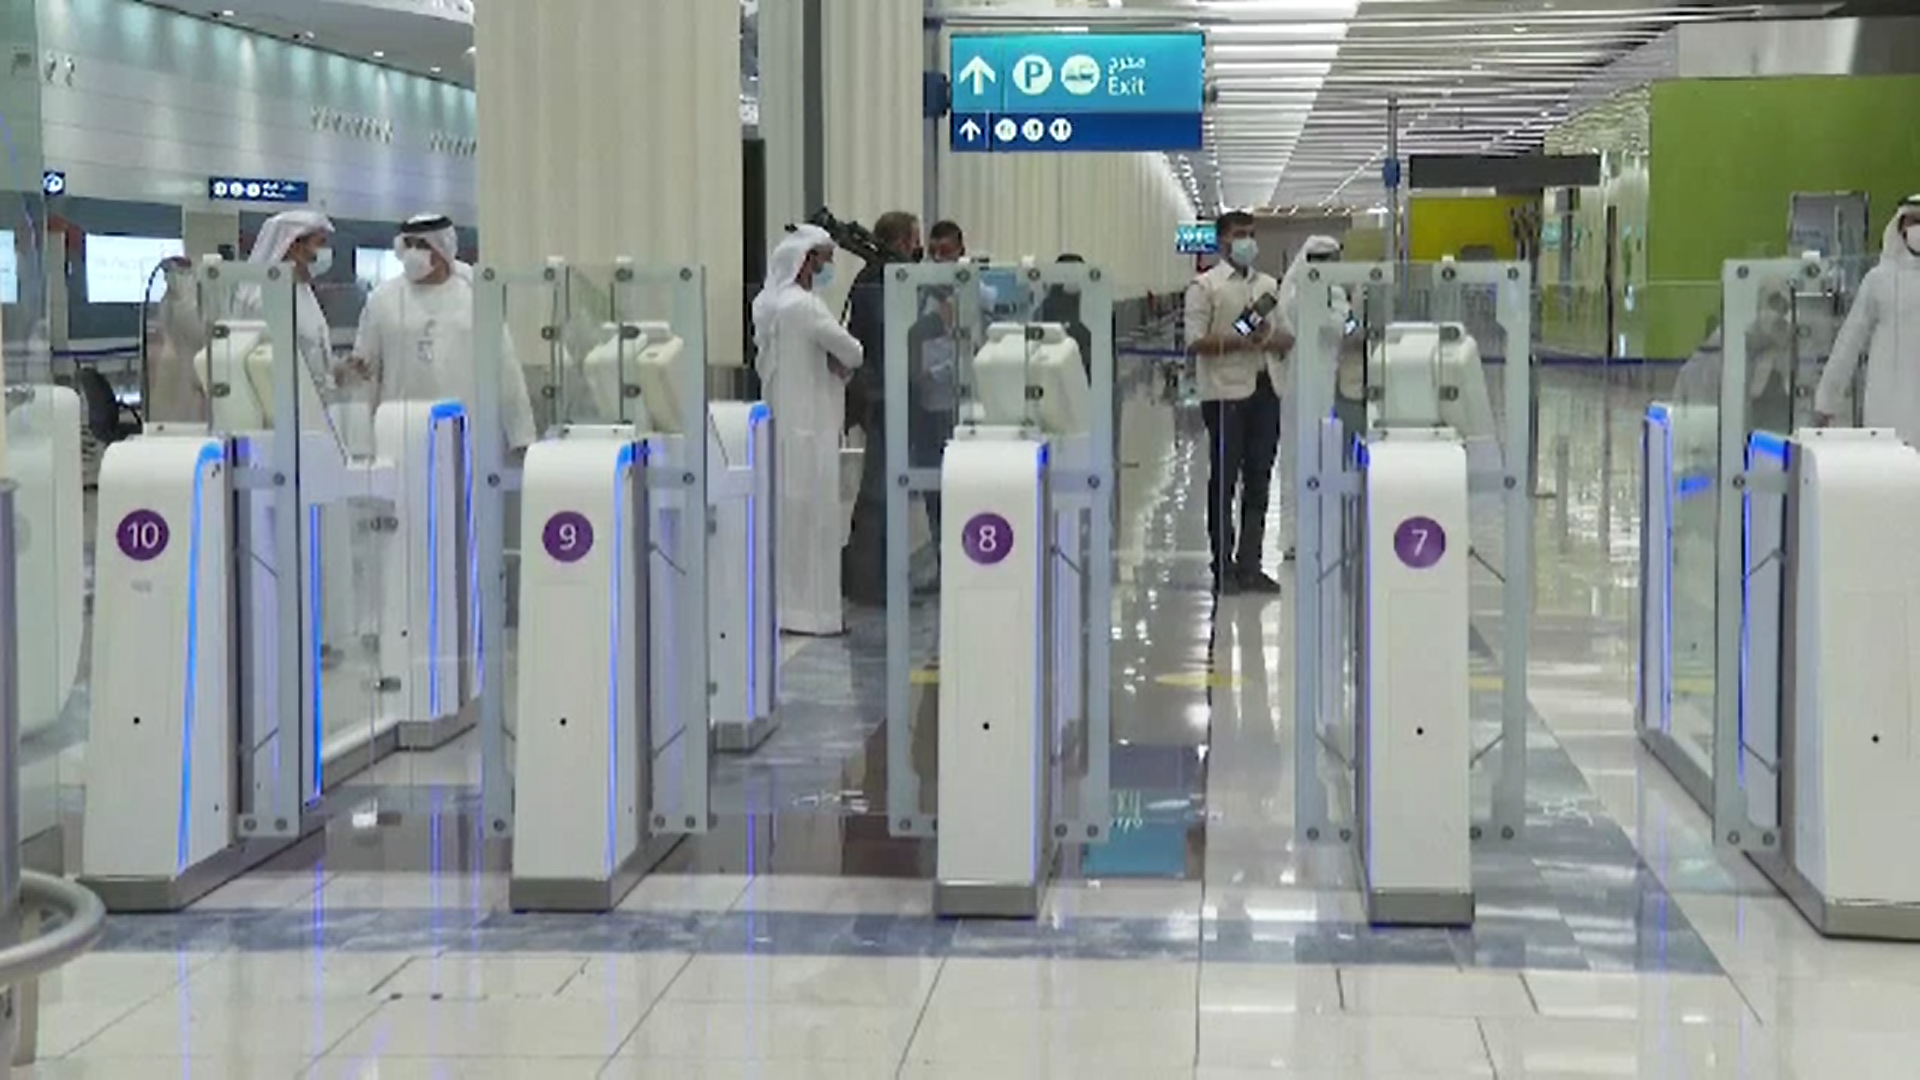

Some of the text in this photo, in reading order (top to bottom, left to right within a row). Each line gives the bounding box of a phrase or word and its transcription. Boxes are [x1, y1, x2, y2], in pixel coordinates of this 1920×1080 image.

[1108, 76, 1146, 96] Exit
[127, 521, 160, 549] 10
[559, 523, 576, 551] 9
[979, 524, 997, 552] 8
[1411, 529, 1428, 556] 7
